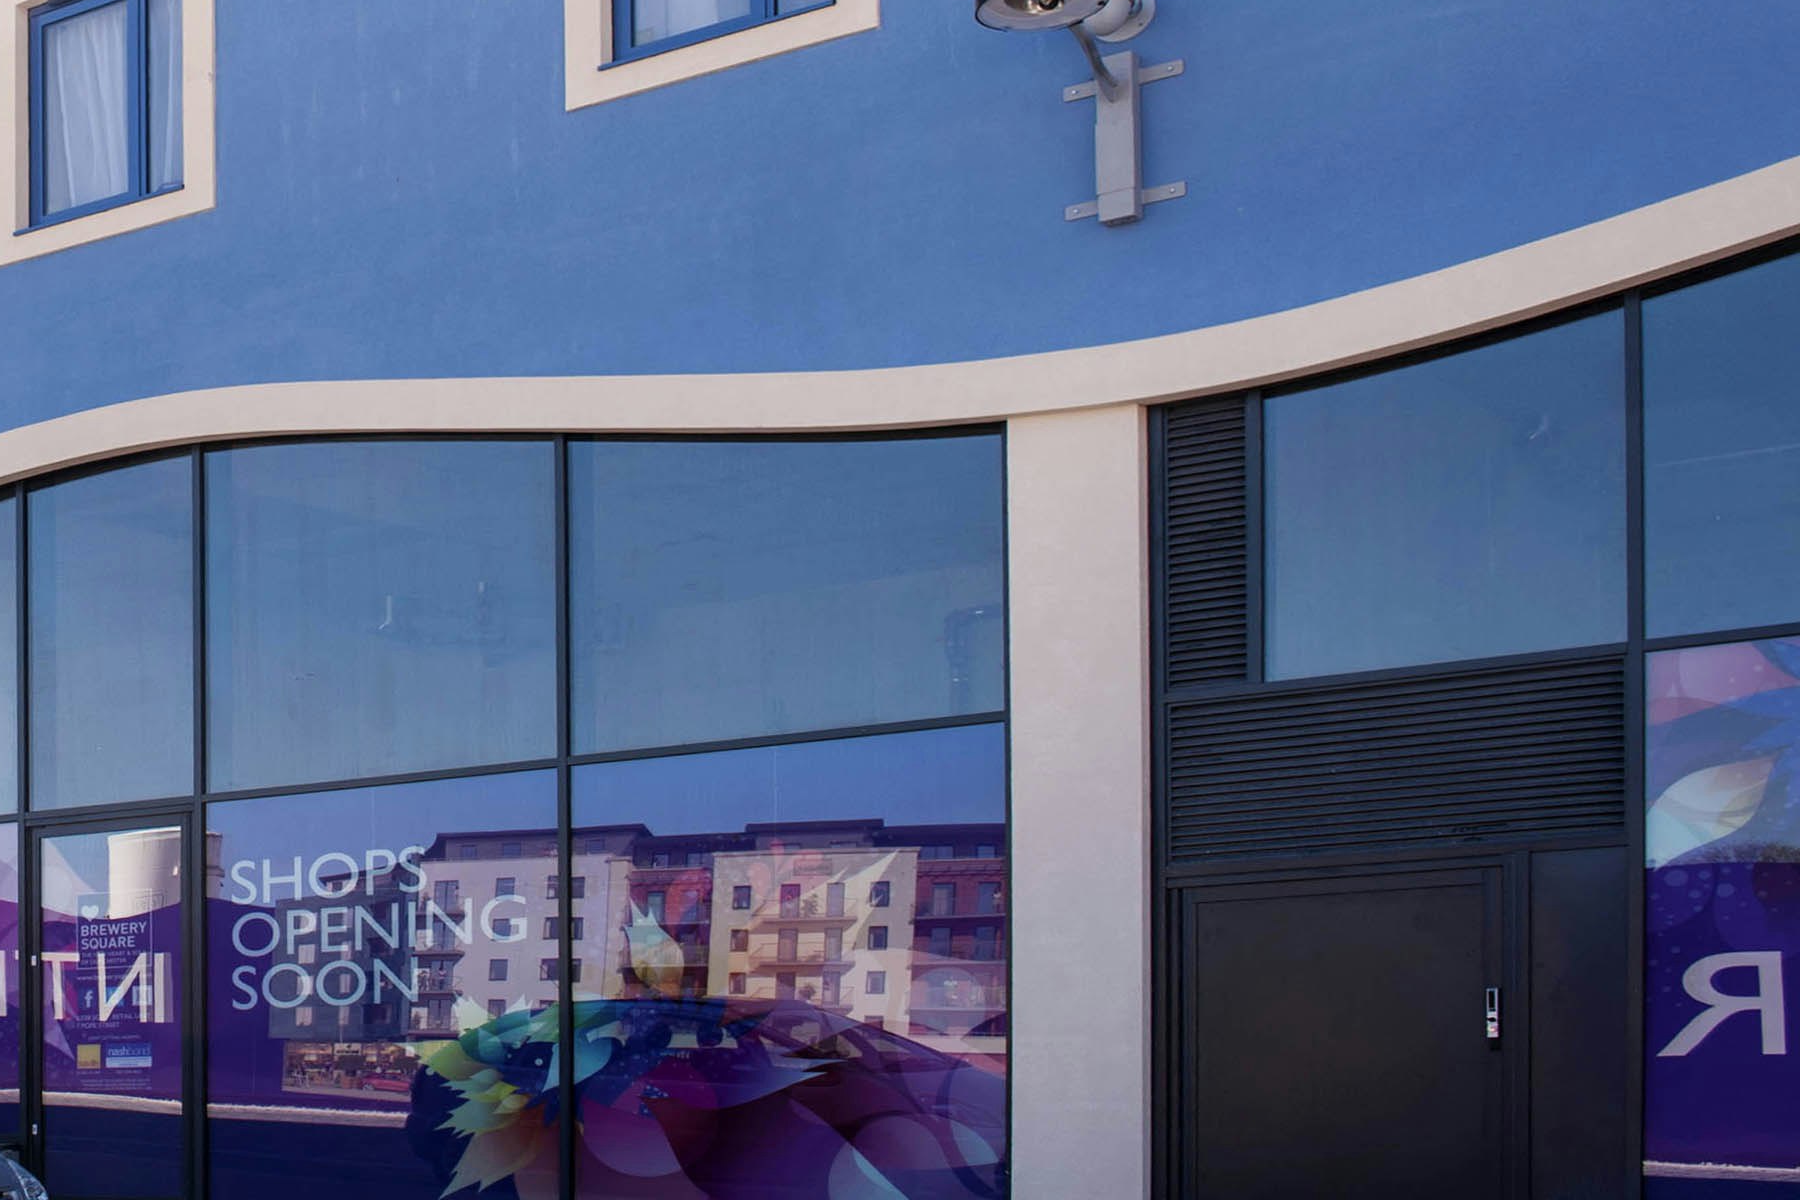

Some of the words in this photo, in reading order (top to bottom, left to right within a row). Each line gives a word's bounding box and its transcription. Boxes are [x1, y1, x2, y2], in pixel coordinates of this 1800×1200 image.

[230, 845, 428, 905] SHOPS
[80, 921, 147, 937] BREWERY
[80, 936, 136, 950] SQUARE
[231, 894, 528, 958] OPENING
[231, 957, 419, 1010] SOON
